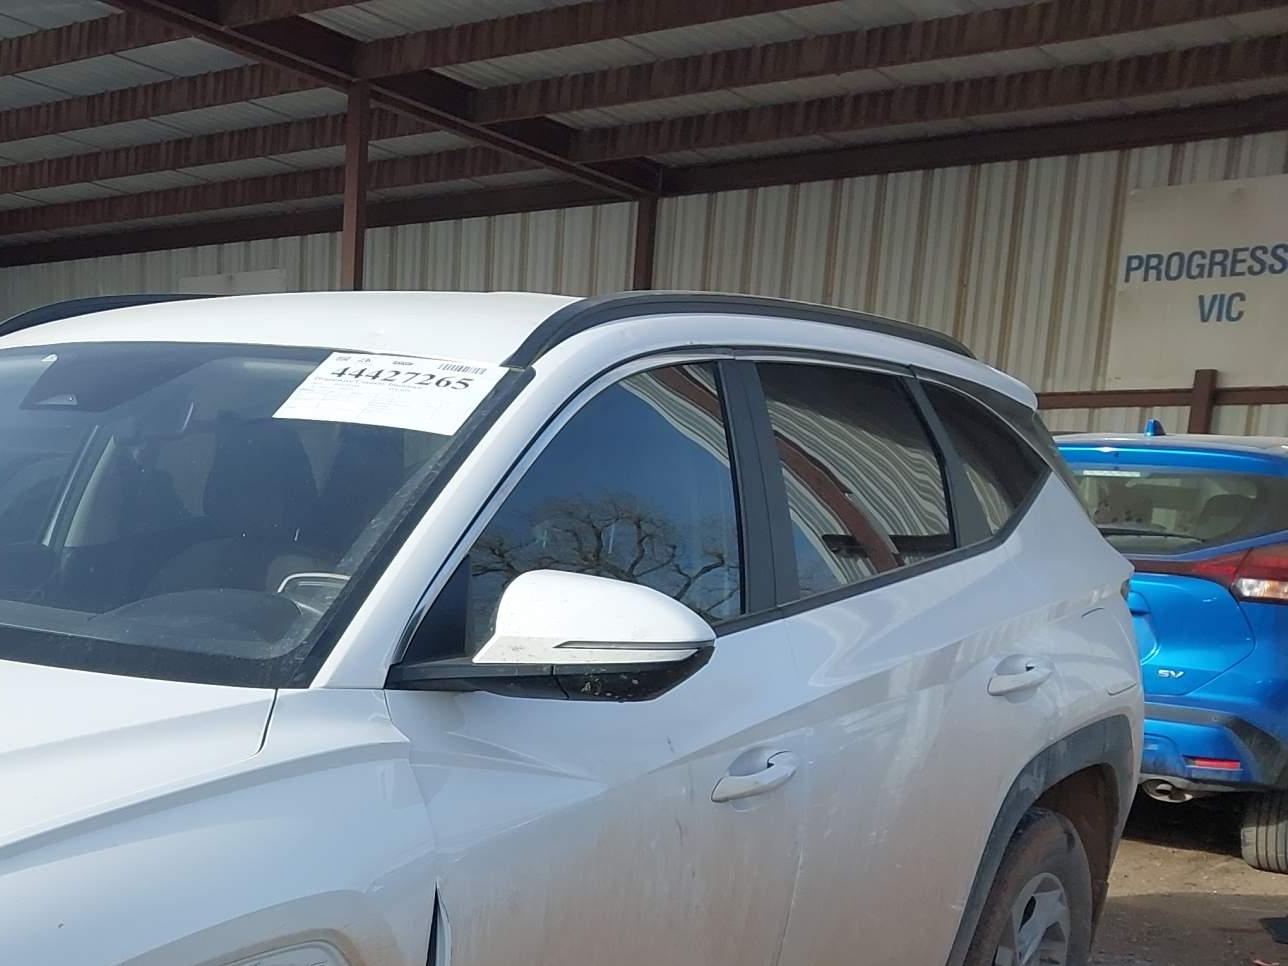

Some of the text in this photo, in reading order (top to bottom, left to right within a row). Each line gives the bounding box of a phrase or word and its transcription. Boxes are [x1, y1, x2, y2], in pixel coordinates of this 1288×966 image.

[1123, 243, 1288, 283] PROGRESS
[1197, 292, 1247, 323] VIC
[331, 366, 474, 390] 44427265
[1158, 669, 1185, 679] SV
